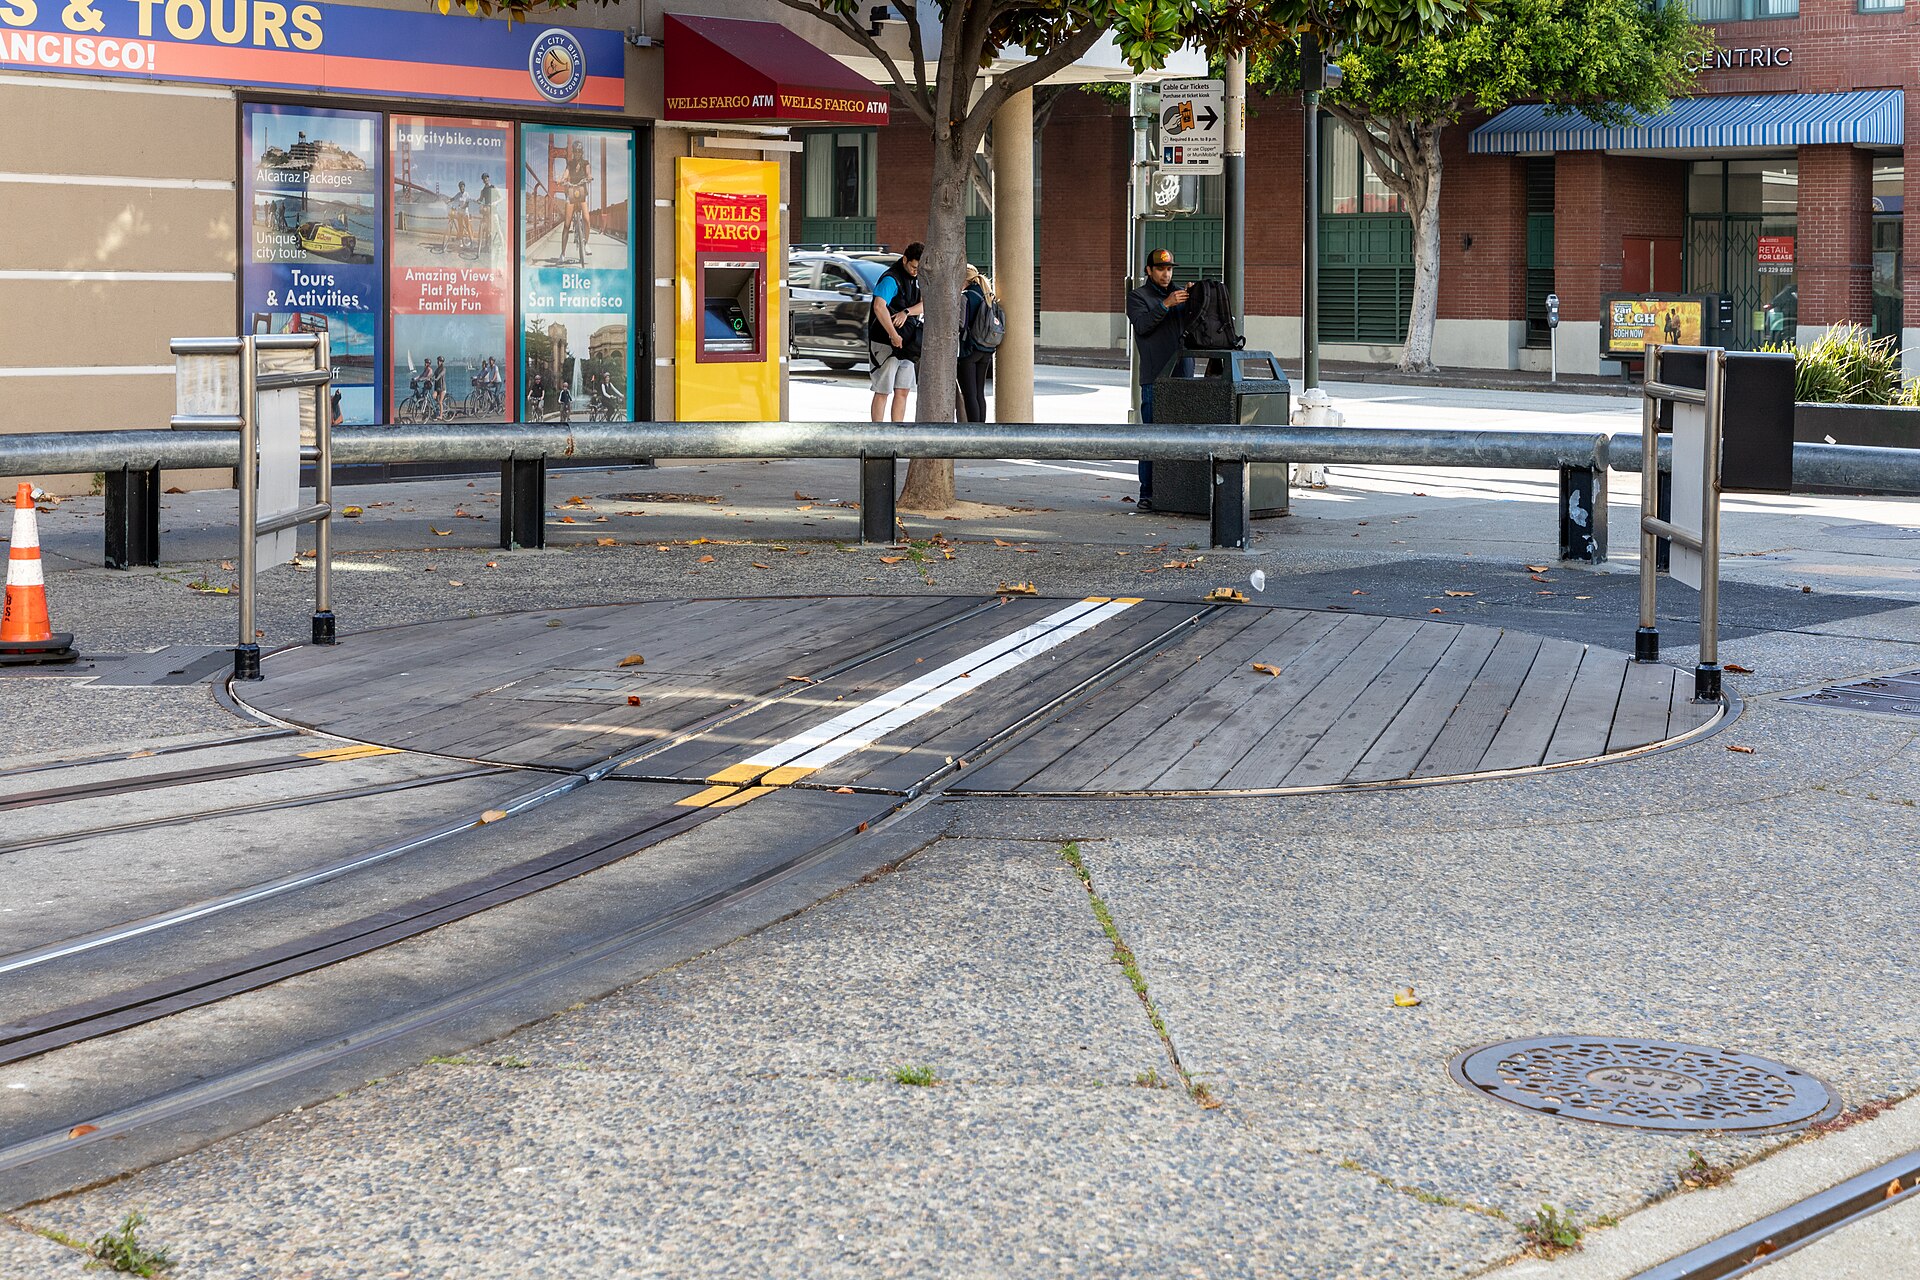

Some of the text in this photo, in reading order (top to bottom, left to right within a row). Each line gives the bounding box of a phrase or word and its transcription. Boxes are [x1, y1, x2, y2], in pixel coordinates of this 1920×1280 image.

[127, 0, 324, 50] TOURS
[535, 36, 580, 66] BAY CITY BIKE
[1683, 47, 1790, 72] CENTRIC
[536, 70, 558, 95] RENTALS
[565, 72, 580, 92] TOURS
[667, 94, 774, 110] WELLS FARGO ATM
[780, 94, 888, 114] WELLS FARGO ATM
[398, 129, 501, 147] baycitybike.com
[256, 170, 352, 187] Alcatraz Packages
[702, 205, 760, 222] WELLS
[256, 232, 297, 248] Unique
[704, 224, 760, 240] FARGO
[256, 246, 276, 261] city
[278, 246, 307, 259] tours
[291, 269, 334, 288] Tours
[405, 269, 495, 285] Amazing Views
[562, 274, 591, 289] Bike
[266, 289, 359, 307] & Activities
[420, 284, 480, 298] Flat Paths,
[418, 298, 482, 314] Family Fun
[528, 292, 623, 308] San Francisco
[1614, 329, 1644, 338] GOGH NOW
